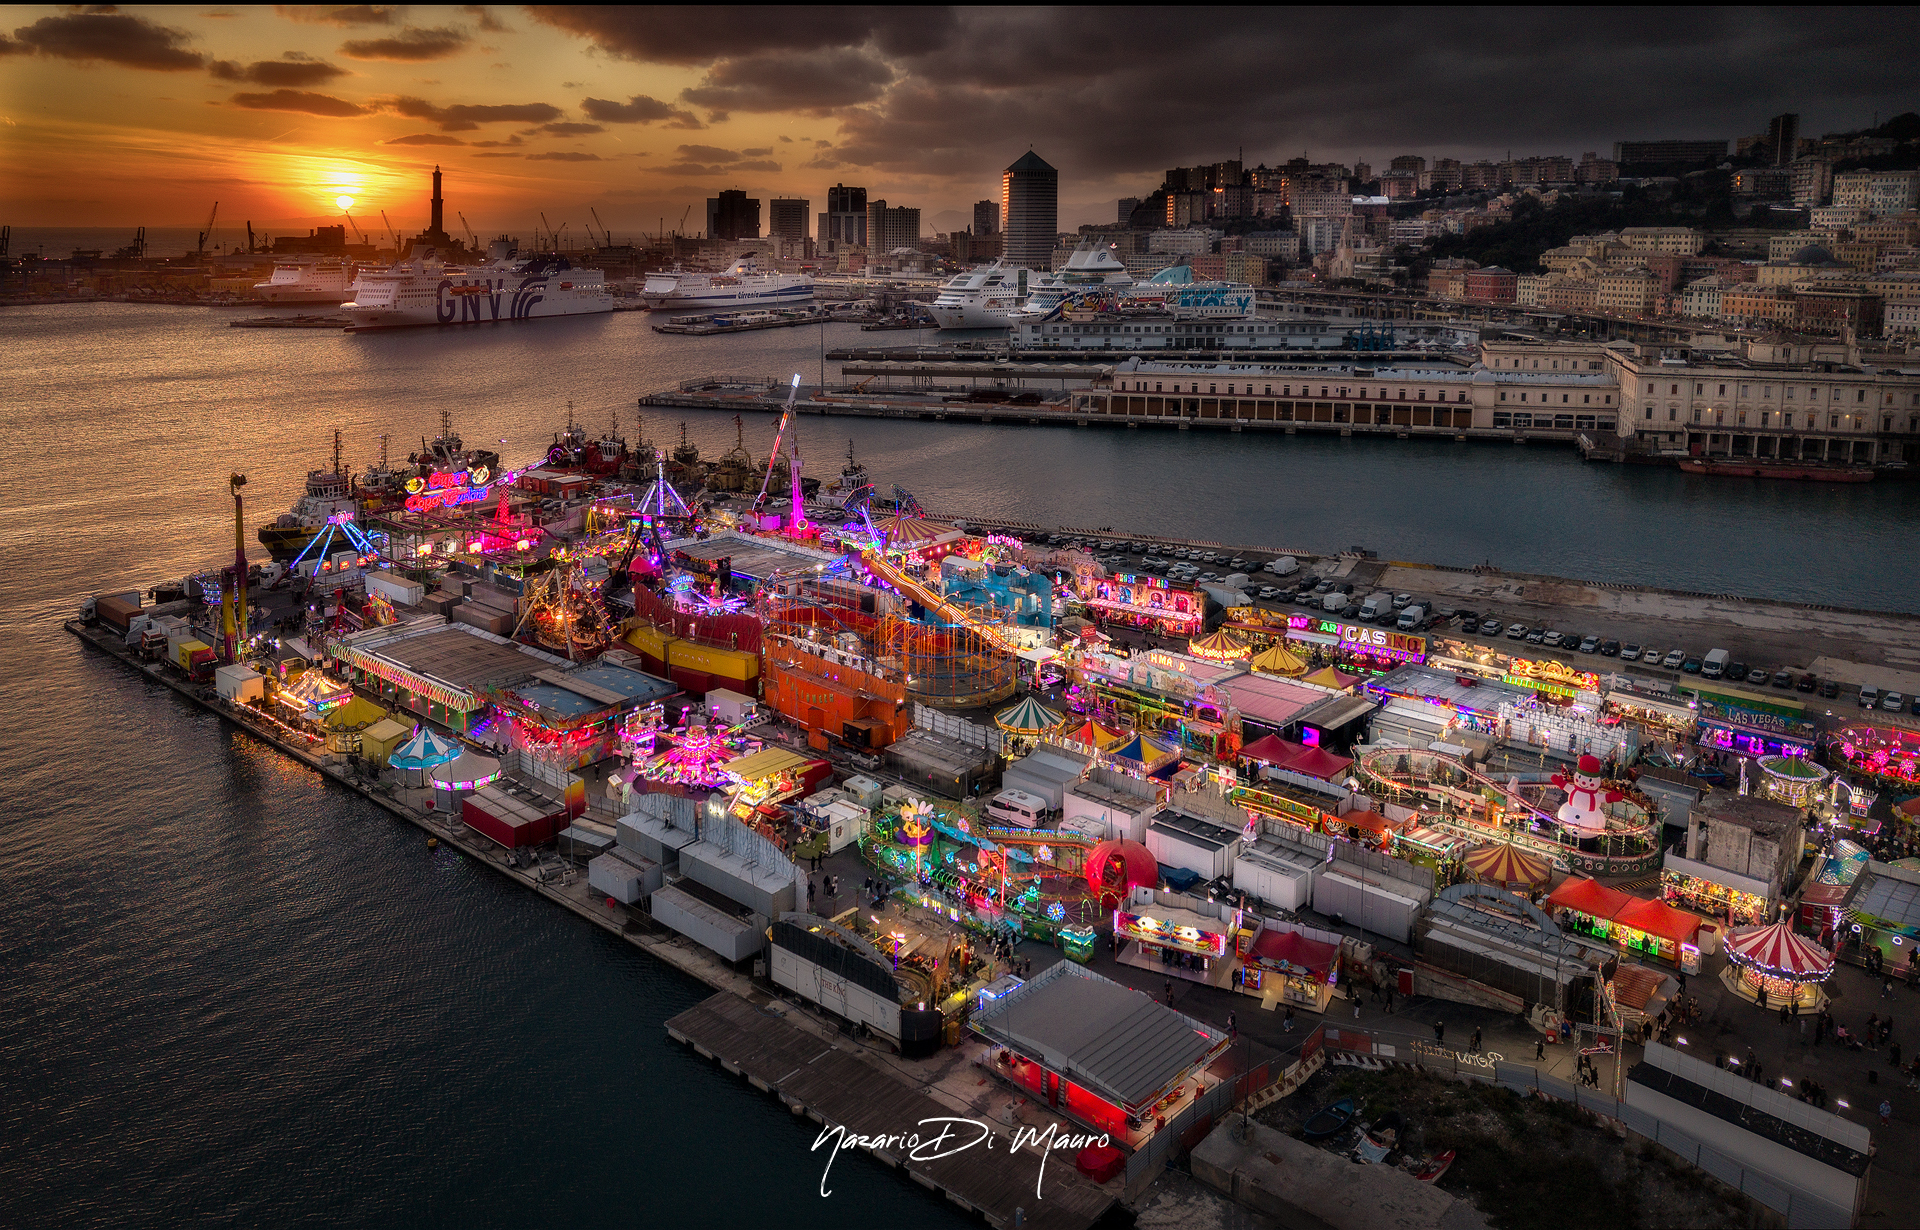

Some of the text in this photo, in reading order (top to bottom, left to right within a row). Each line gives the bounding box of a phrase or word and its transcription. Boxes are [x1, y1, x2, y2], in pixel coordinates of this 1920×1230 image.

[437, 278, 504, 324] GNV
[428, 471, 469, 490] Super
[1115, 572, 1169, 590] GHOST TRAIN
[1728, 708, 1786, 728] LAS VEGAS
[1239, 789, 1269, 804] PLAY
[1326, 816, 1348, 833] App
[821, 979, 832, 991] THE
